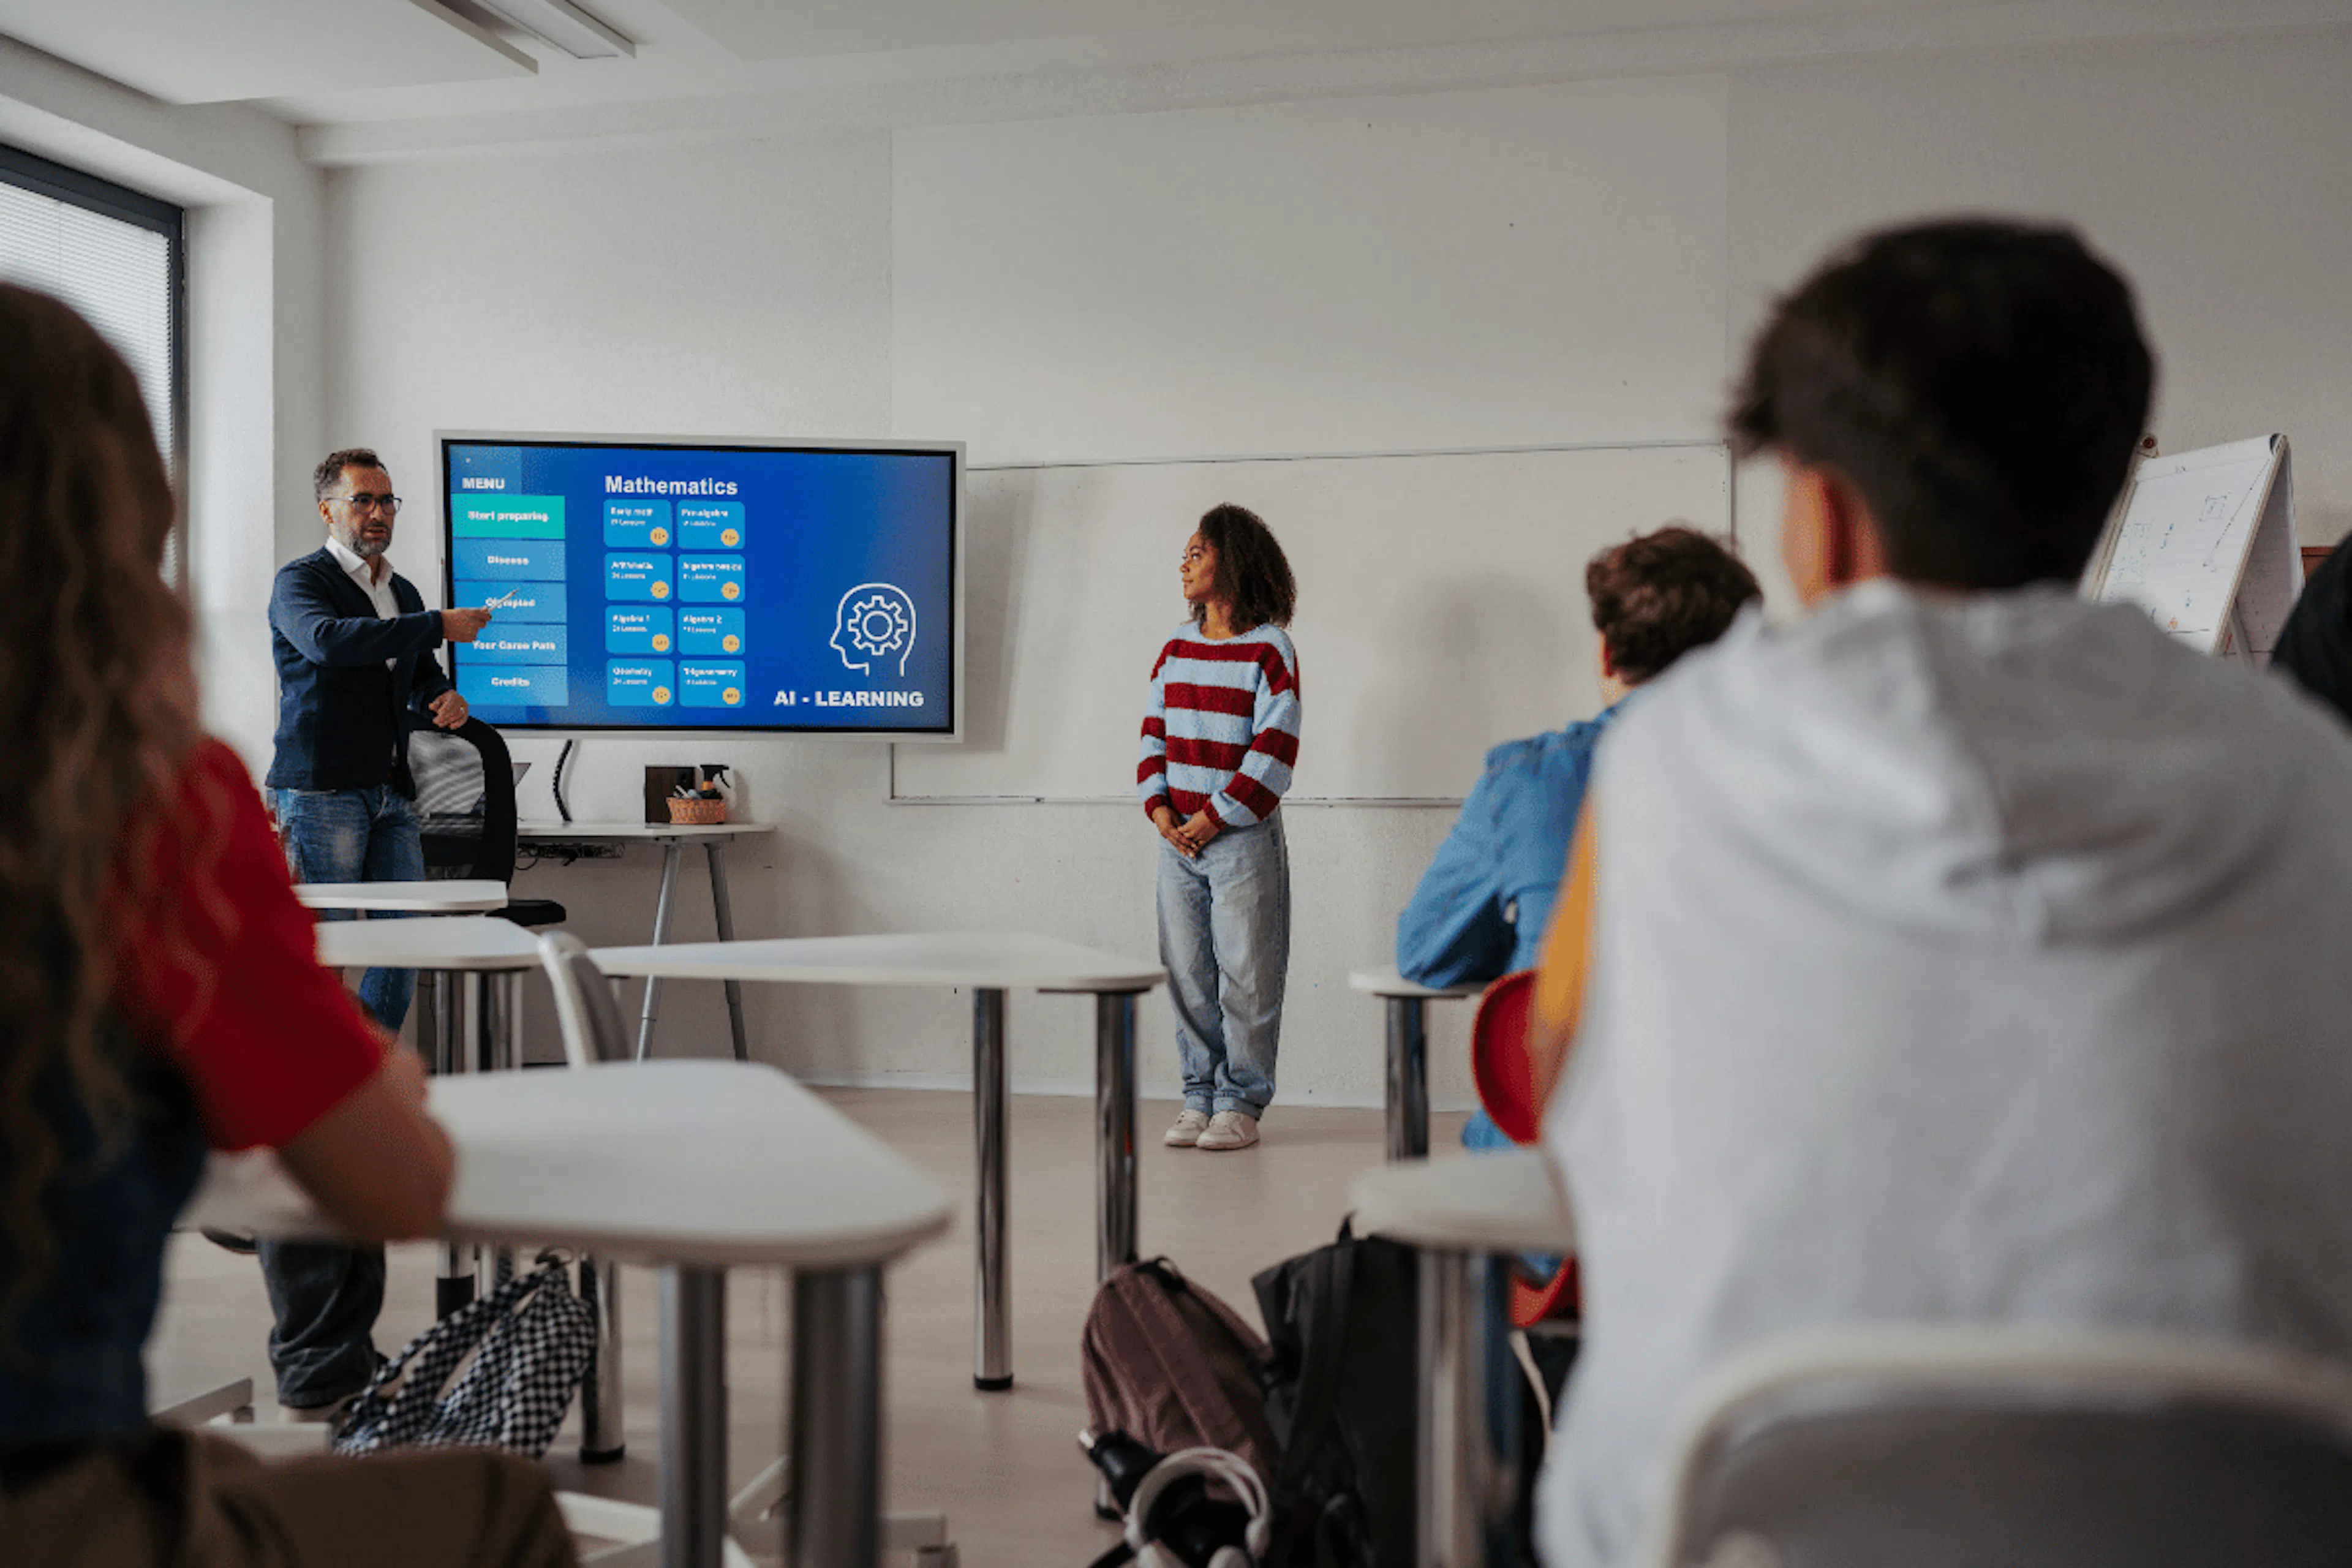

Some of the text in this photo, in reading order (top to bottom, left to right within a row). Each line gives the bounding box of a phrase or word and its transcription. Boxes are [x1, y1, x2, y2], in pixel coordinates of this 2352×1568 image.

[462, 477, 505, 489] MENU
[605, 475, 738, 495] Mathematics
[468, 511, 549, 522] Start preparing
[472, 641, 496, 650] Your
[532, 641, 556, 650] Path
[491, 677, 530, 687] Credits
[774, 690, 796, 706] AI
[815, 690, 925, 707] LEARNING
